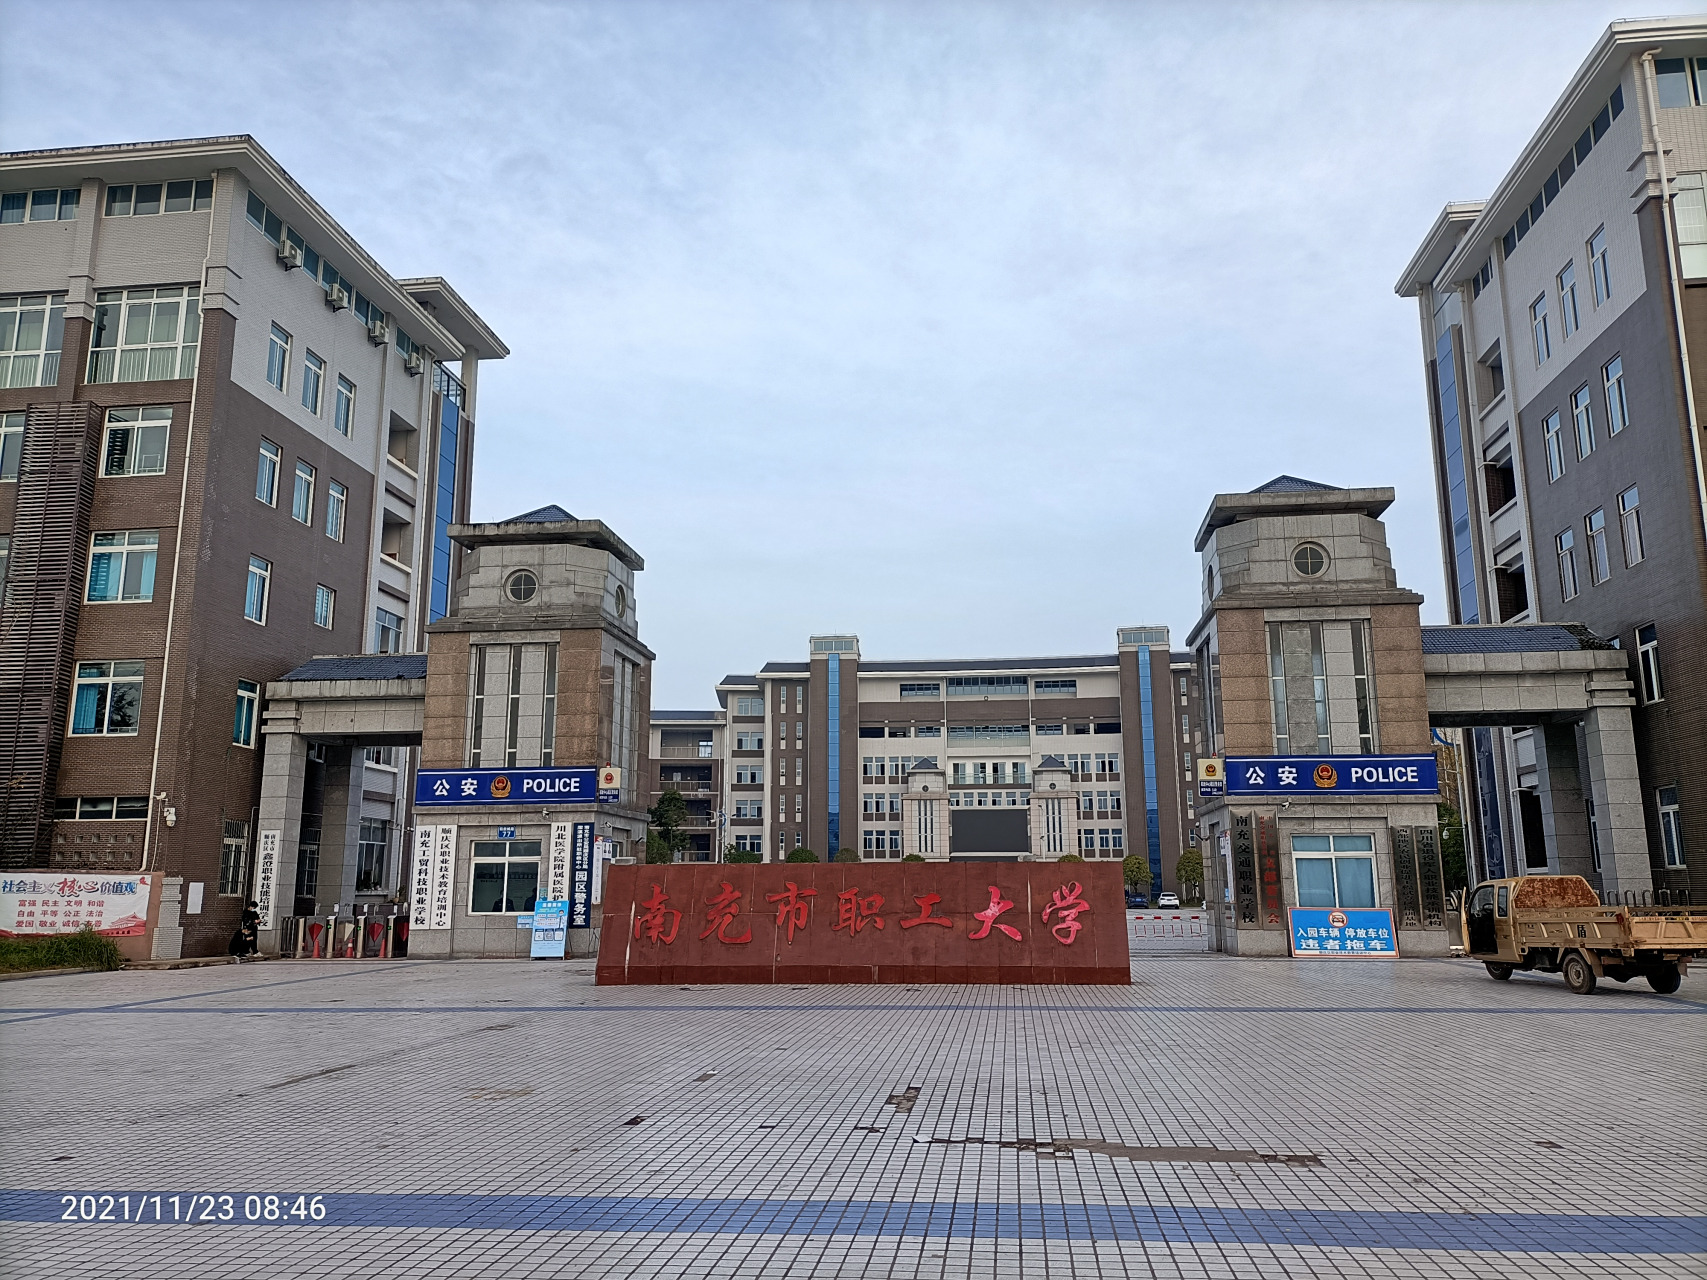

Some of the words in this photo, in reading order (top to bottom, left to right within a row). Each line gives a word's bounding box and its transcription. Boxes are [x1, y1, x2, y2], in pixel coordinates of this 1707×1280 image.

[1245, 765, 1298, 786] 公安
[1350, 766, 1419, 783] POLICE
[432, 778, 478, 797] 公安
[522, 777, 581, 793] POLICE
[413, 829, 431, 925] 南充工贸科技职业学校
[434, 827, 452, 927] 顺庆区职业技术教育培训中心
[1235, 815, 1256, 924] 南充交通职业学校
[2, 877, 138, 898] 社会主义核心价值观
[18, 899, 37, 908] 富强
[41, 899, 60, 908] 民主
[64, 899, 83, 908] 文明
[87, 899, 105, 908] 和谐
[573, 871, 588, 926] 园区警务室
[17, 909, 35, 918] 自由
[40, 909, 59, 918] 平等
[63, 909, 81, 918] 公正
[85, 909, 104, 918] 法治
[633, 881, 1092, 946] 南充市职工大学
[15, 919, 35, 928] 爱国
[38, 919, 58, 928] 敬业
[62, 919, 81, 928] 诚信
[1297, 927, 1341, 938] 入园车辆
[1344, 927, 1390, 939] 停放车位
[1299, 939, 1388, 950] 违者拖车
